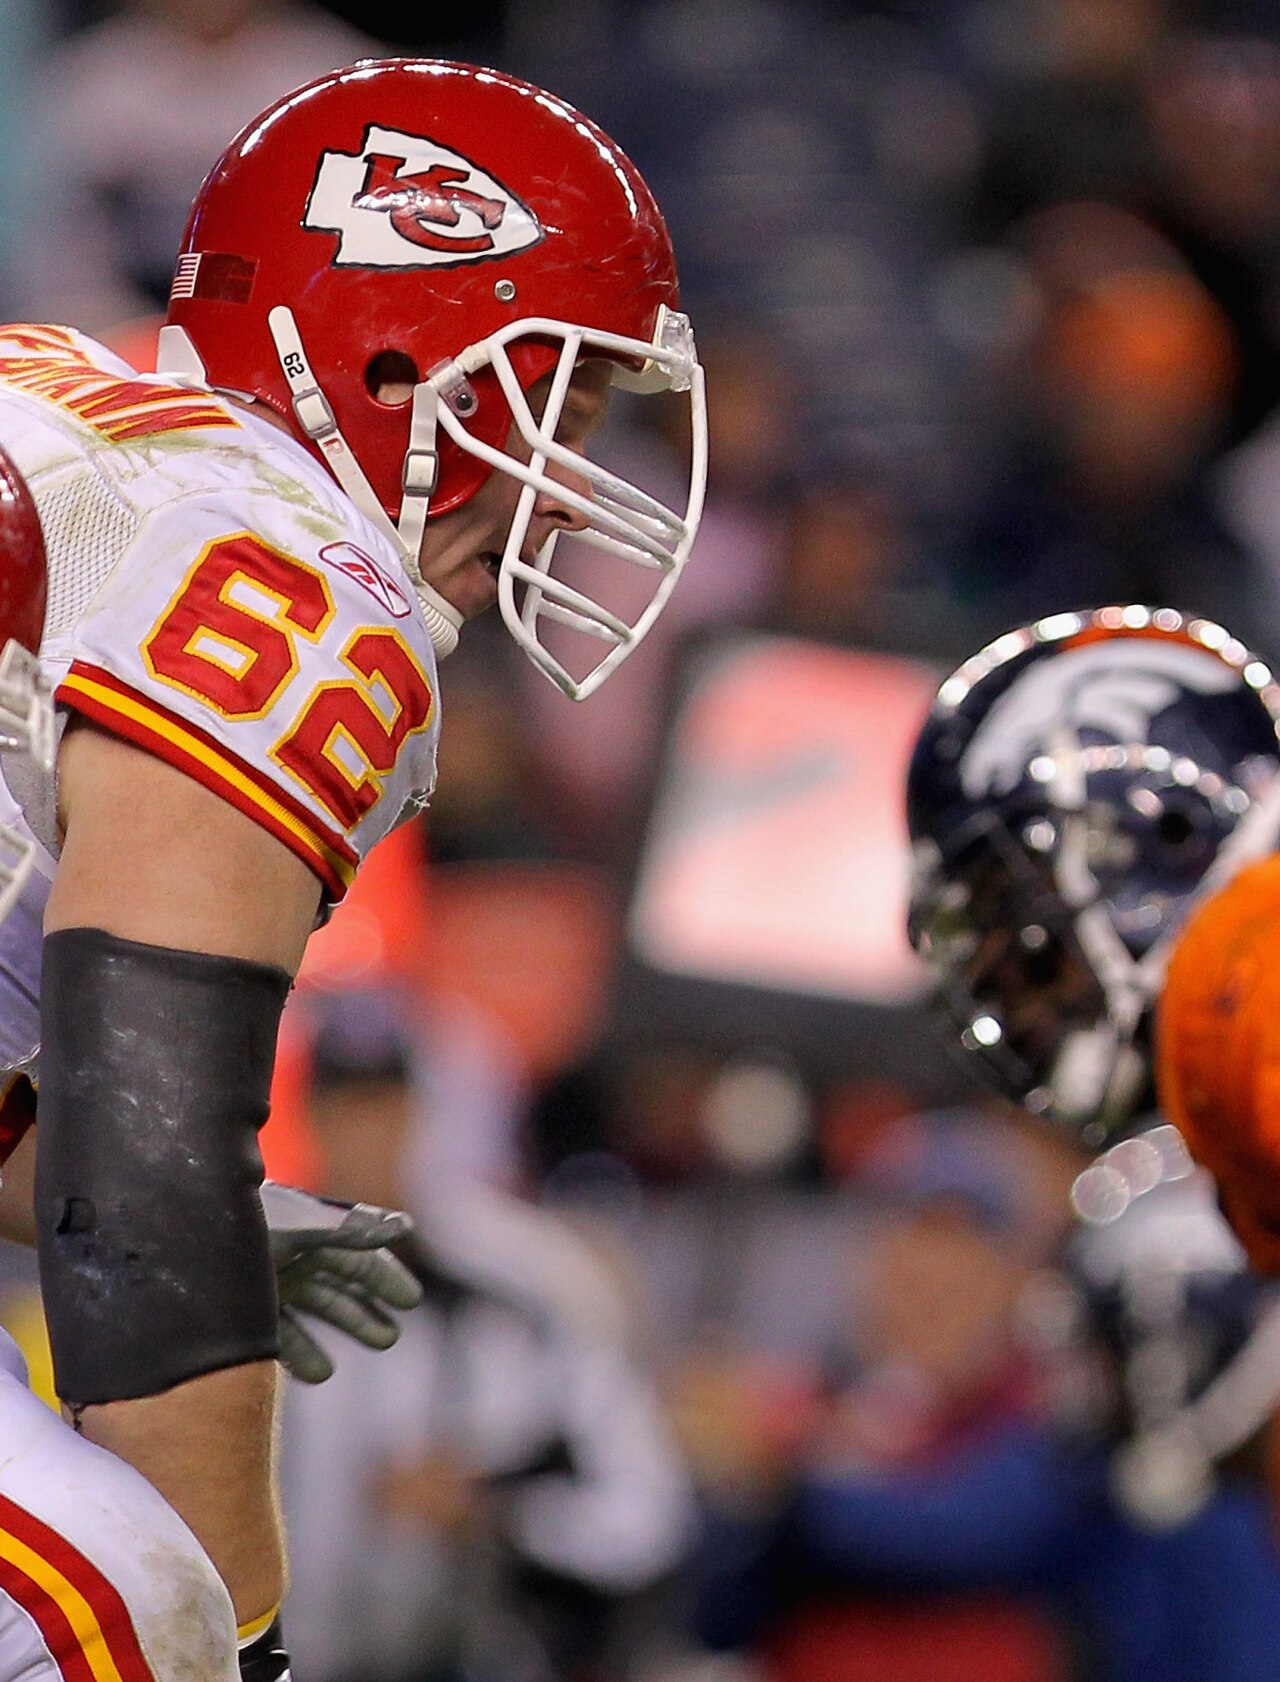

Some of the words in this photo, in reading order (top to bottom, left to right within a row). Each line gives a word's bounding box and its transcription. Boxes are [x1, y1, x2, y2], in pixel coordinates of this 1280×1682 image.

[350, 152, 507, 253] KC
[282, 352, 305, 378] 62
[138, 529, 433, 835] 62
